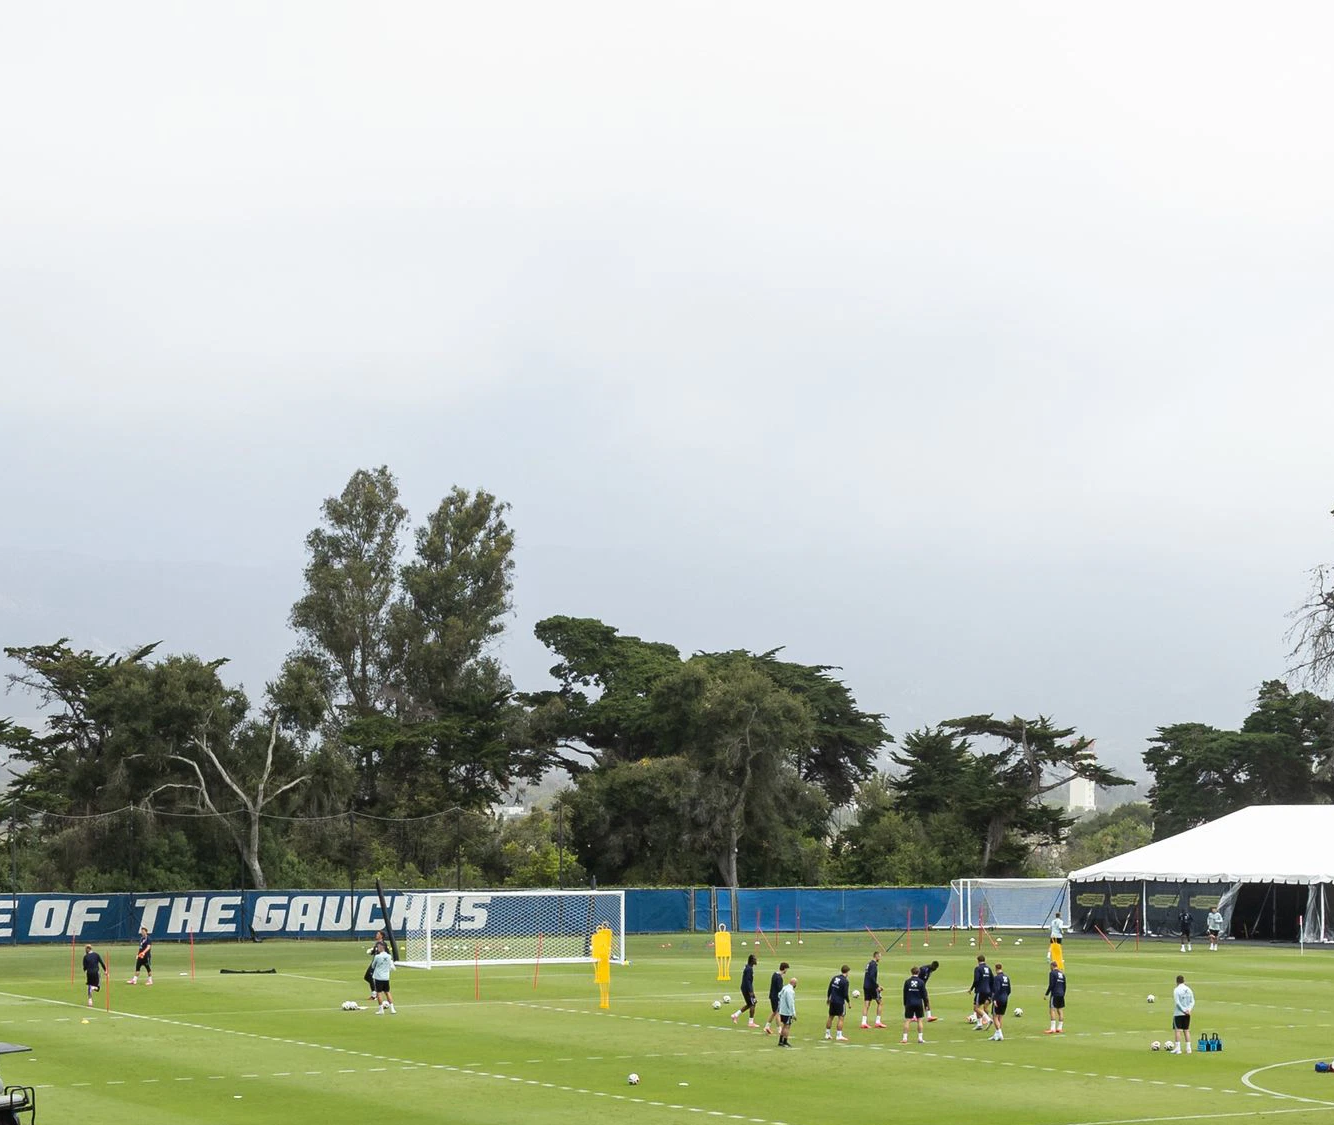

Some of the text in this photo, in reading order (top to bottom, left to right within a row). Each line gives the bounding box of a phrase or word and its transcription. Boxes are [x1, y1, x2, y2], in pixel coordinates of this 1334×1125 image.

[27, 898, 110, 938] OF
[135, 895, 243, 934] THE
[245, 895, 493, 933] GAUCHOS
